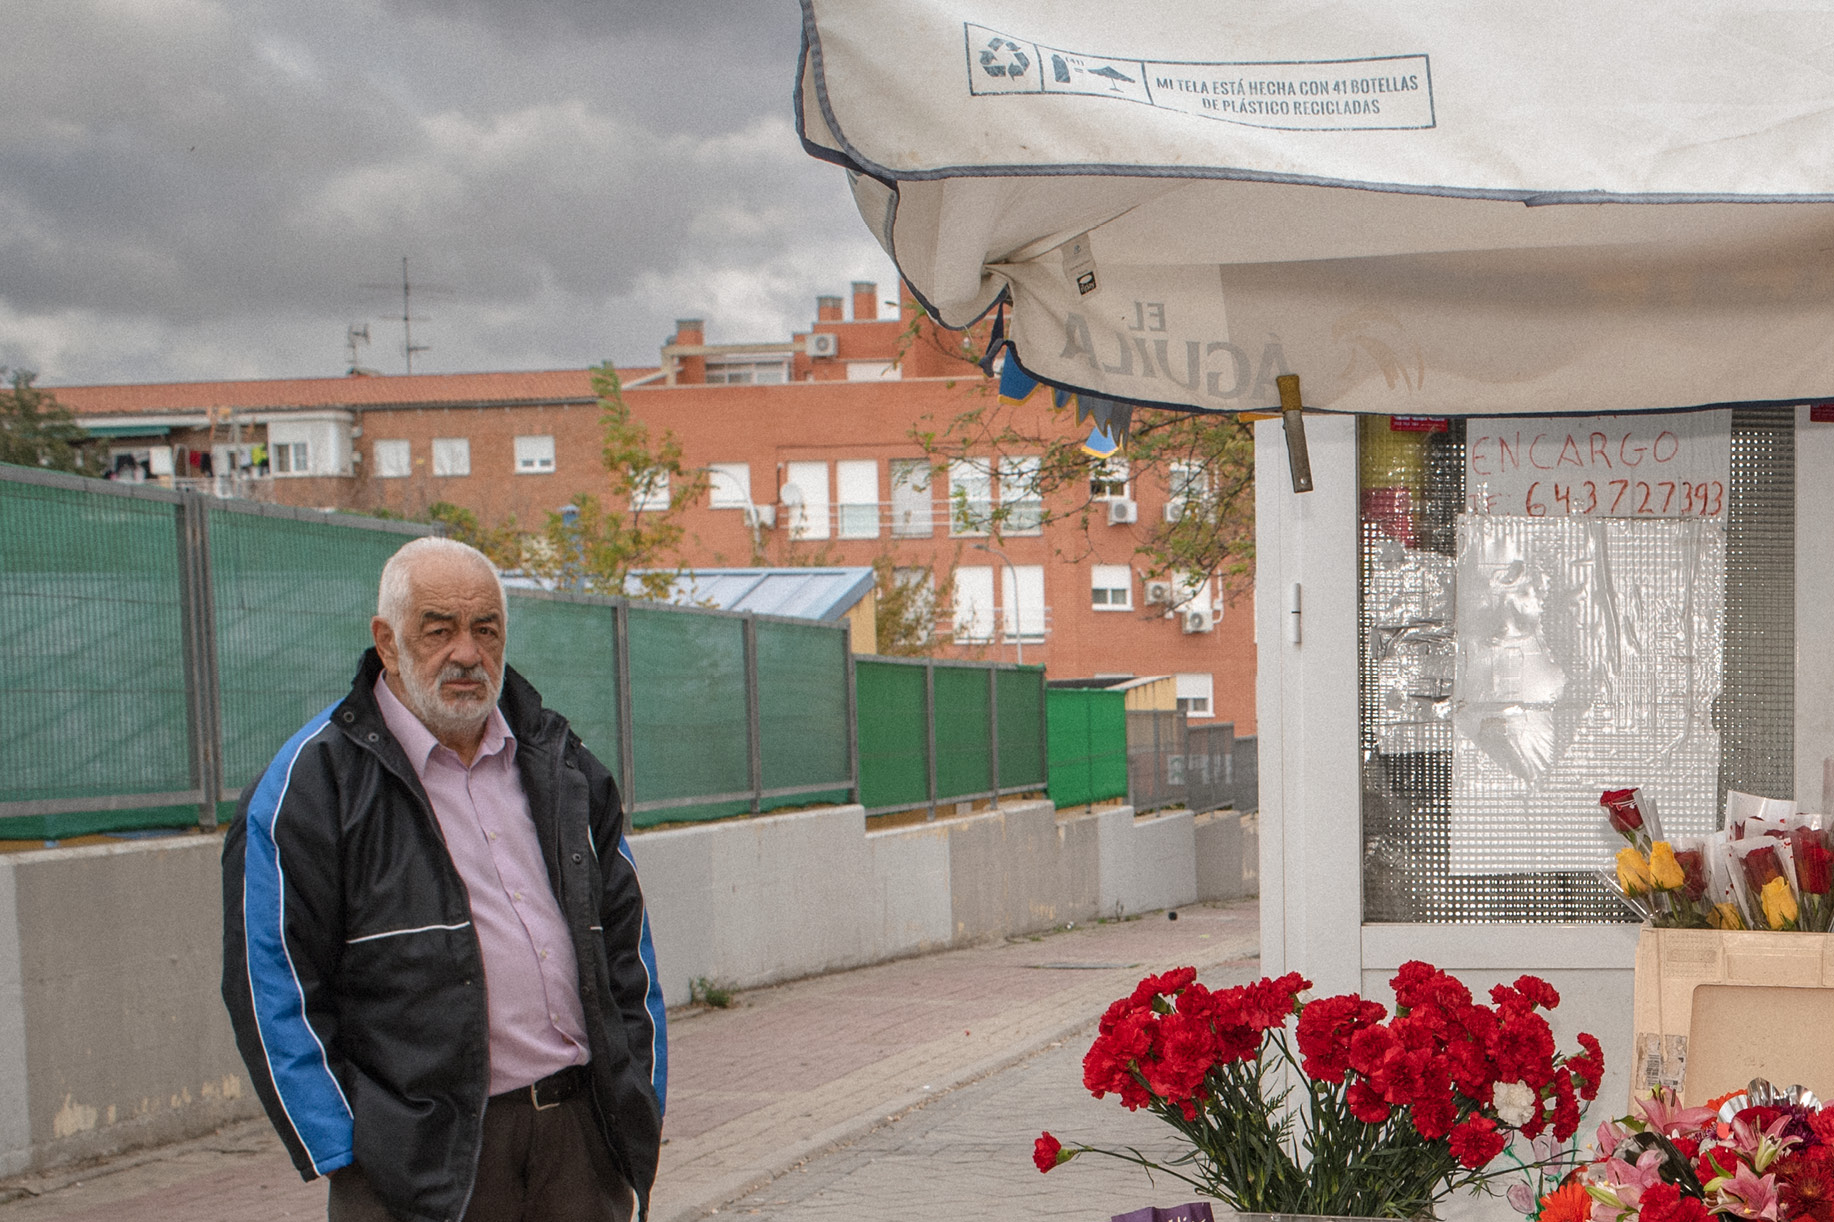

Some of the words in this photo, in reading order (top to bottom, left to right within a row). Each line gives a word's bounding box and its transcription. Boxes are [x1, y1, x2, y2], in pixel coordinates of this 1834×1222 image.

[1156, 77, 1173, 90] MI
[1178, 79, 1209, 95] TELA
[1212, 78, 1246, 96] ESTÁ
[1249, 80, 1296, 96] HECHA
[1300, 79, 1330, 95] CON
[1332, 79, 1348, 94] 41
[1351, 75, 1419, 93] BOTELLAS
[1202, 98, 1220, 111] DE
[1222, 97, 1290, 115] PLÁSTICO
[1294, 99, 1380, 116] RECICLADAS
[1472, 430, 1679, 476] ENCARGO
